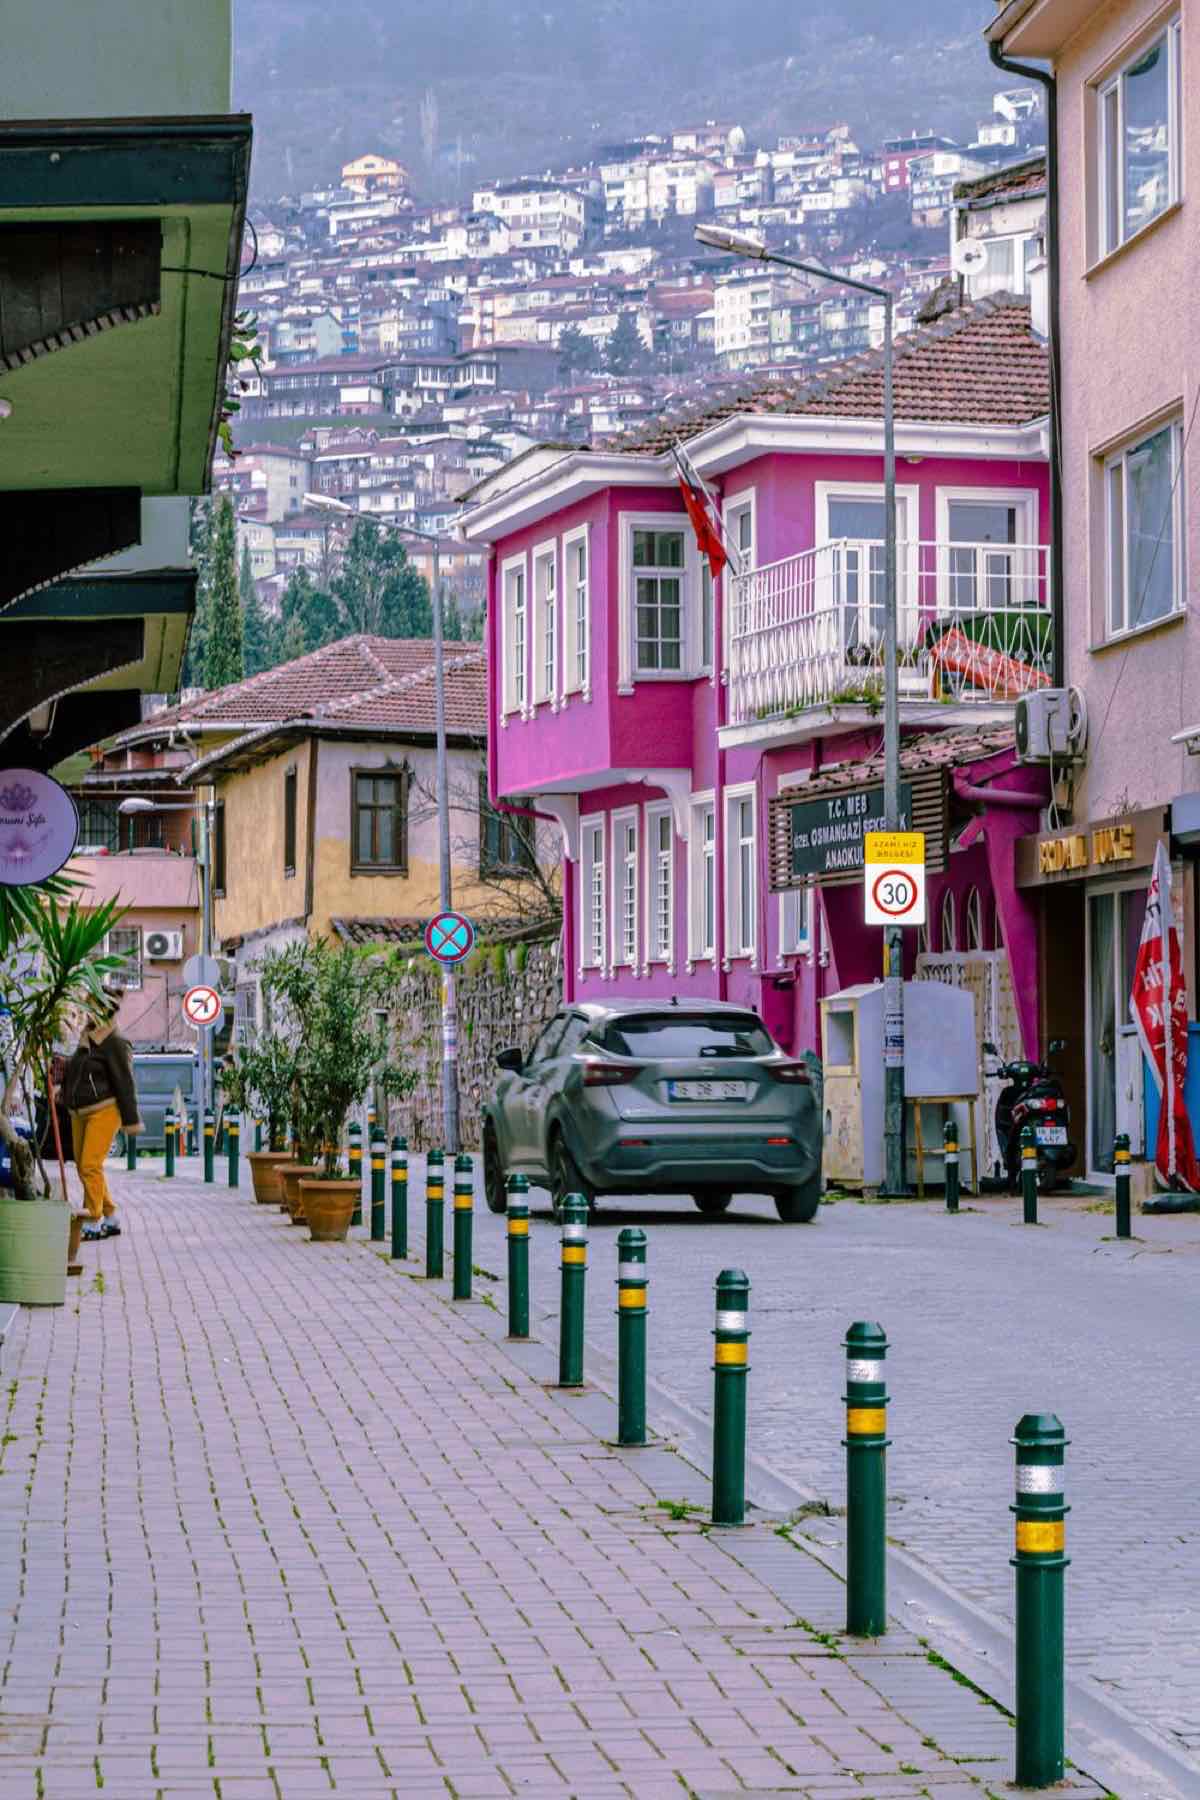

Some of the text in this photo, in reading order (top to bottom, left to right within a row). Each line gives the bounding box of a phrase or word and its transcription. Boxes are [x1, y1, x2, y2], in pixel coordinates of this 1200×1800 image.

[828, 794, 868, 820] T.C. MEB
[811, 816, 863, 847] OSMANGAZİ
[883, 883, 908, 906] 30
